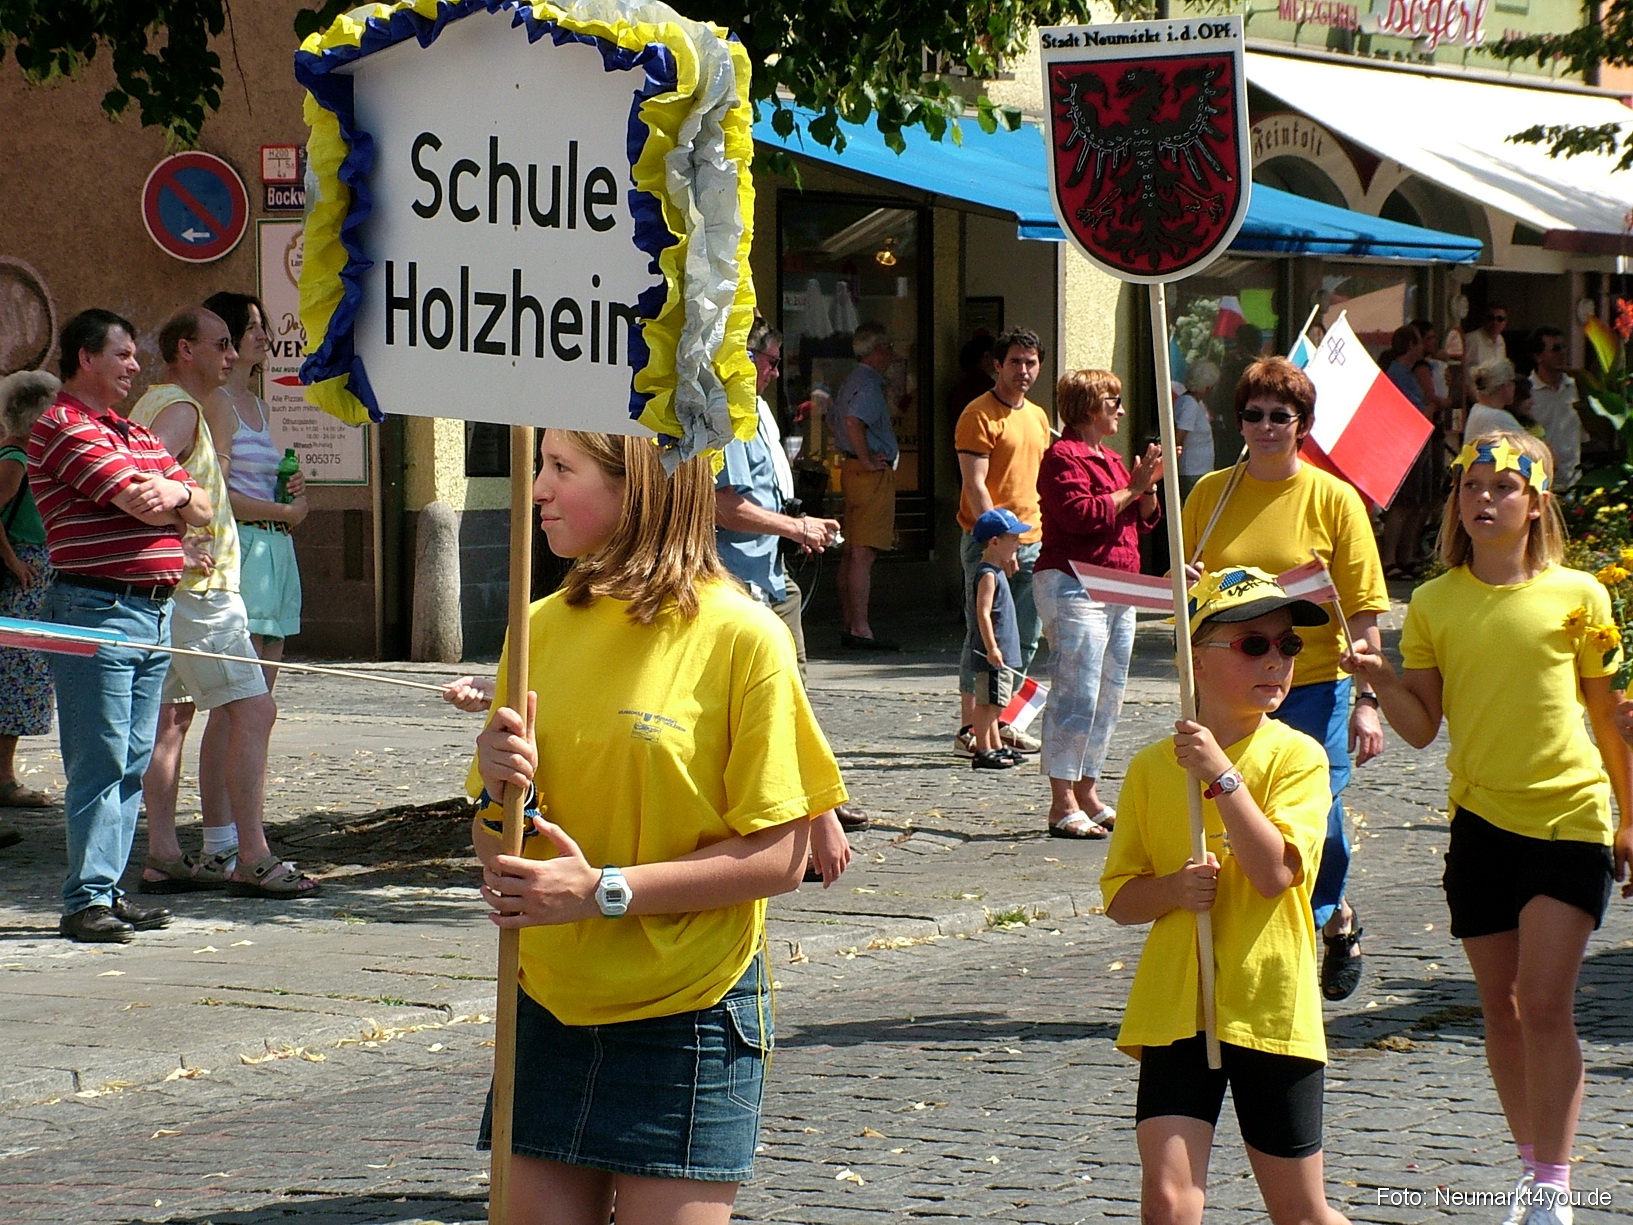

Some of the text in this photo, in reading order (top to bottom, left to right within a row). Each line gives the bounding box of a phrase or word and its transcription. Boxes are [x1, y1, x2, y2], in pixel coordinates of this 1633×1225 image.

[1041, 33, 1080, 49] Stadt
[1083, 28, 1161, 47] Neumarkt
[410, 131, 618, 232] Schule
[305, 454, 341, 465] 905375
